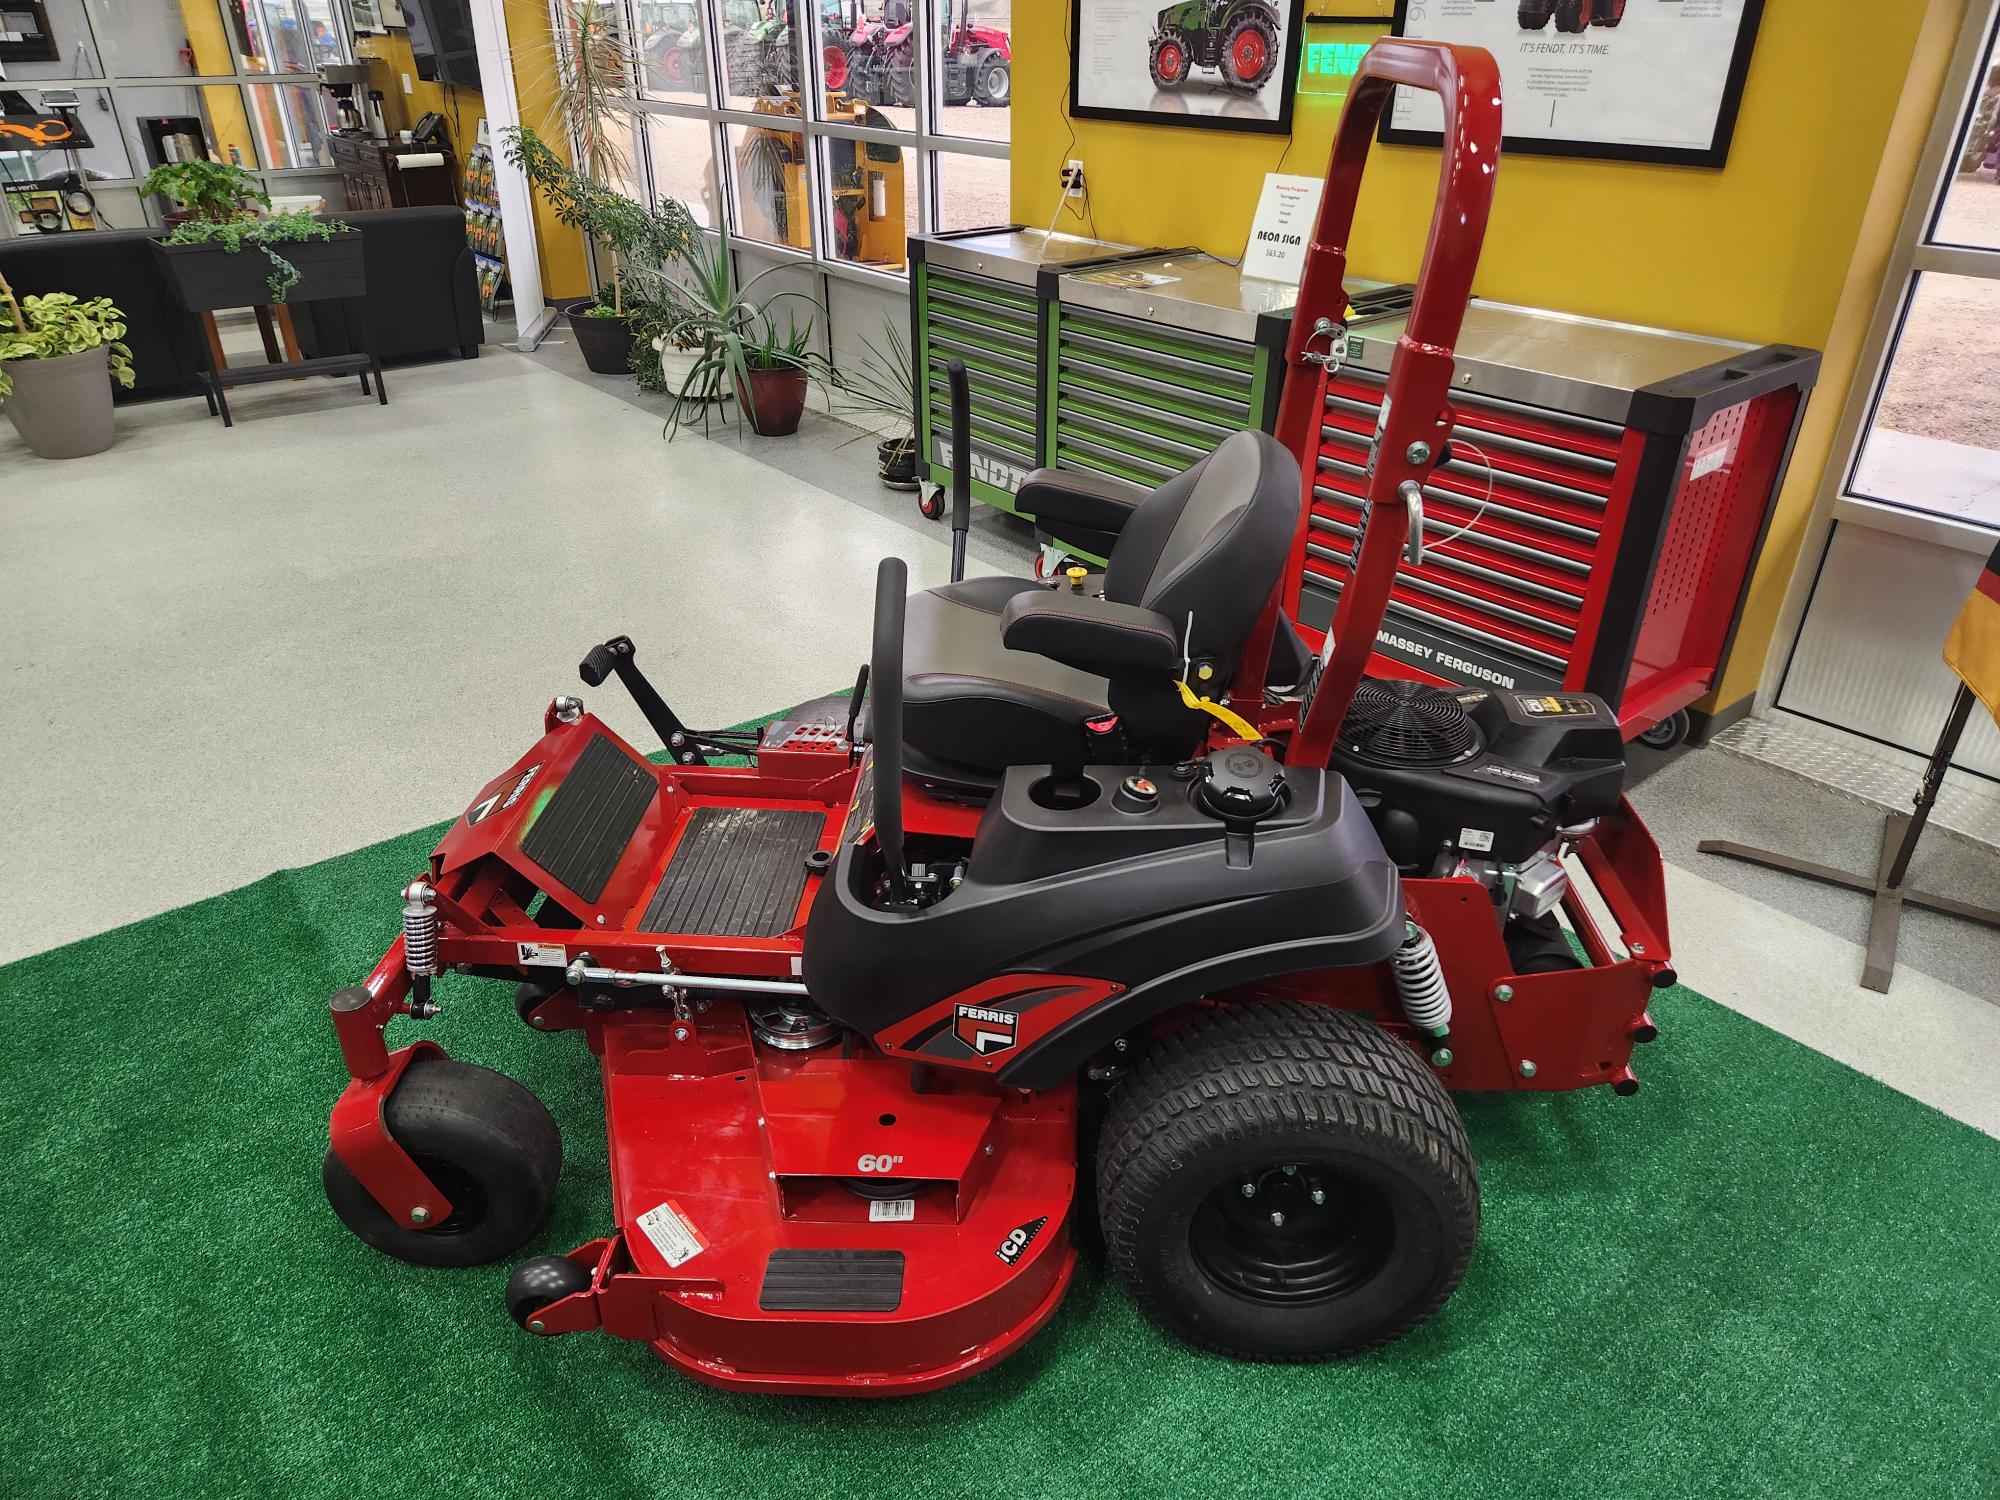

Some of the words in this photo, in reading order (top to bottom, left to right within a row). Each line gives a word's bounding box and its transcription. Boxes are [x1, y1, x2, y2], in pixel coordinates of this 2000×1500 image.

[1519, 43, 1535, 53] IT'S
[1535, 43, 1565, 54] FENDT.
[1568, 44, 1586, 54] IT'S
[1587, 44, 1610, 55] TIME.
[1257, 231, 1280, 242] NEON
[1282, 234, 1301, 245] SIGN
[1376, 630, 1433, 659] MASSEY
[1436, 651, 1515, 690] FERGUSON
[958, 1006, 1014, 1025] FERRIS
[857, 1154, 903, 1173] 60"
